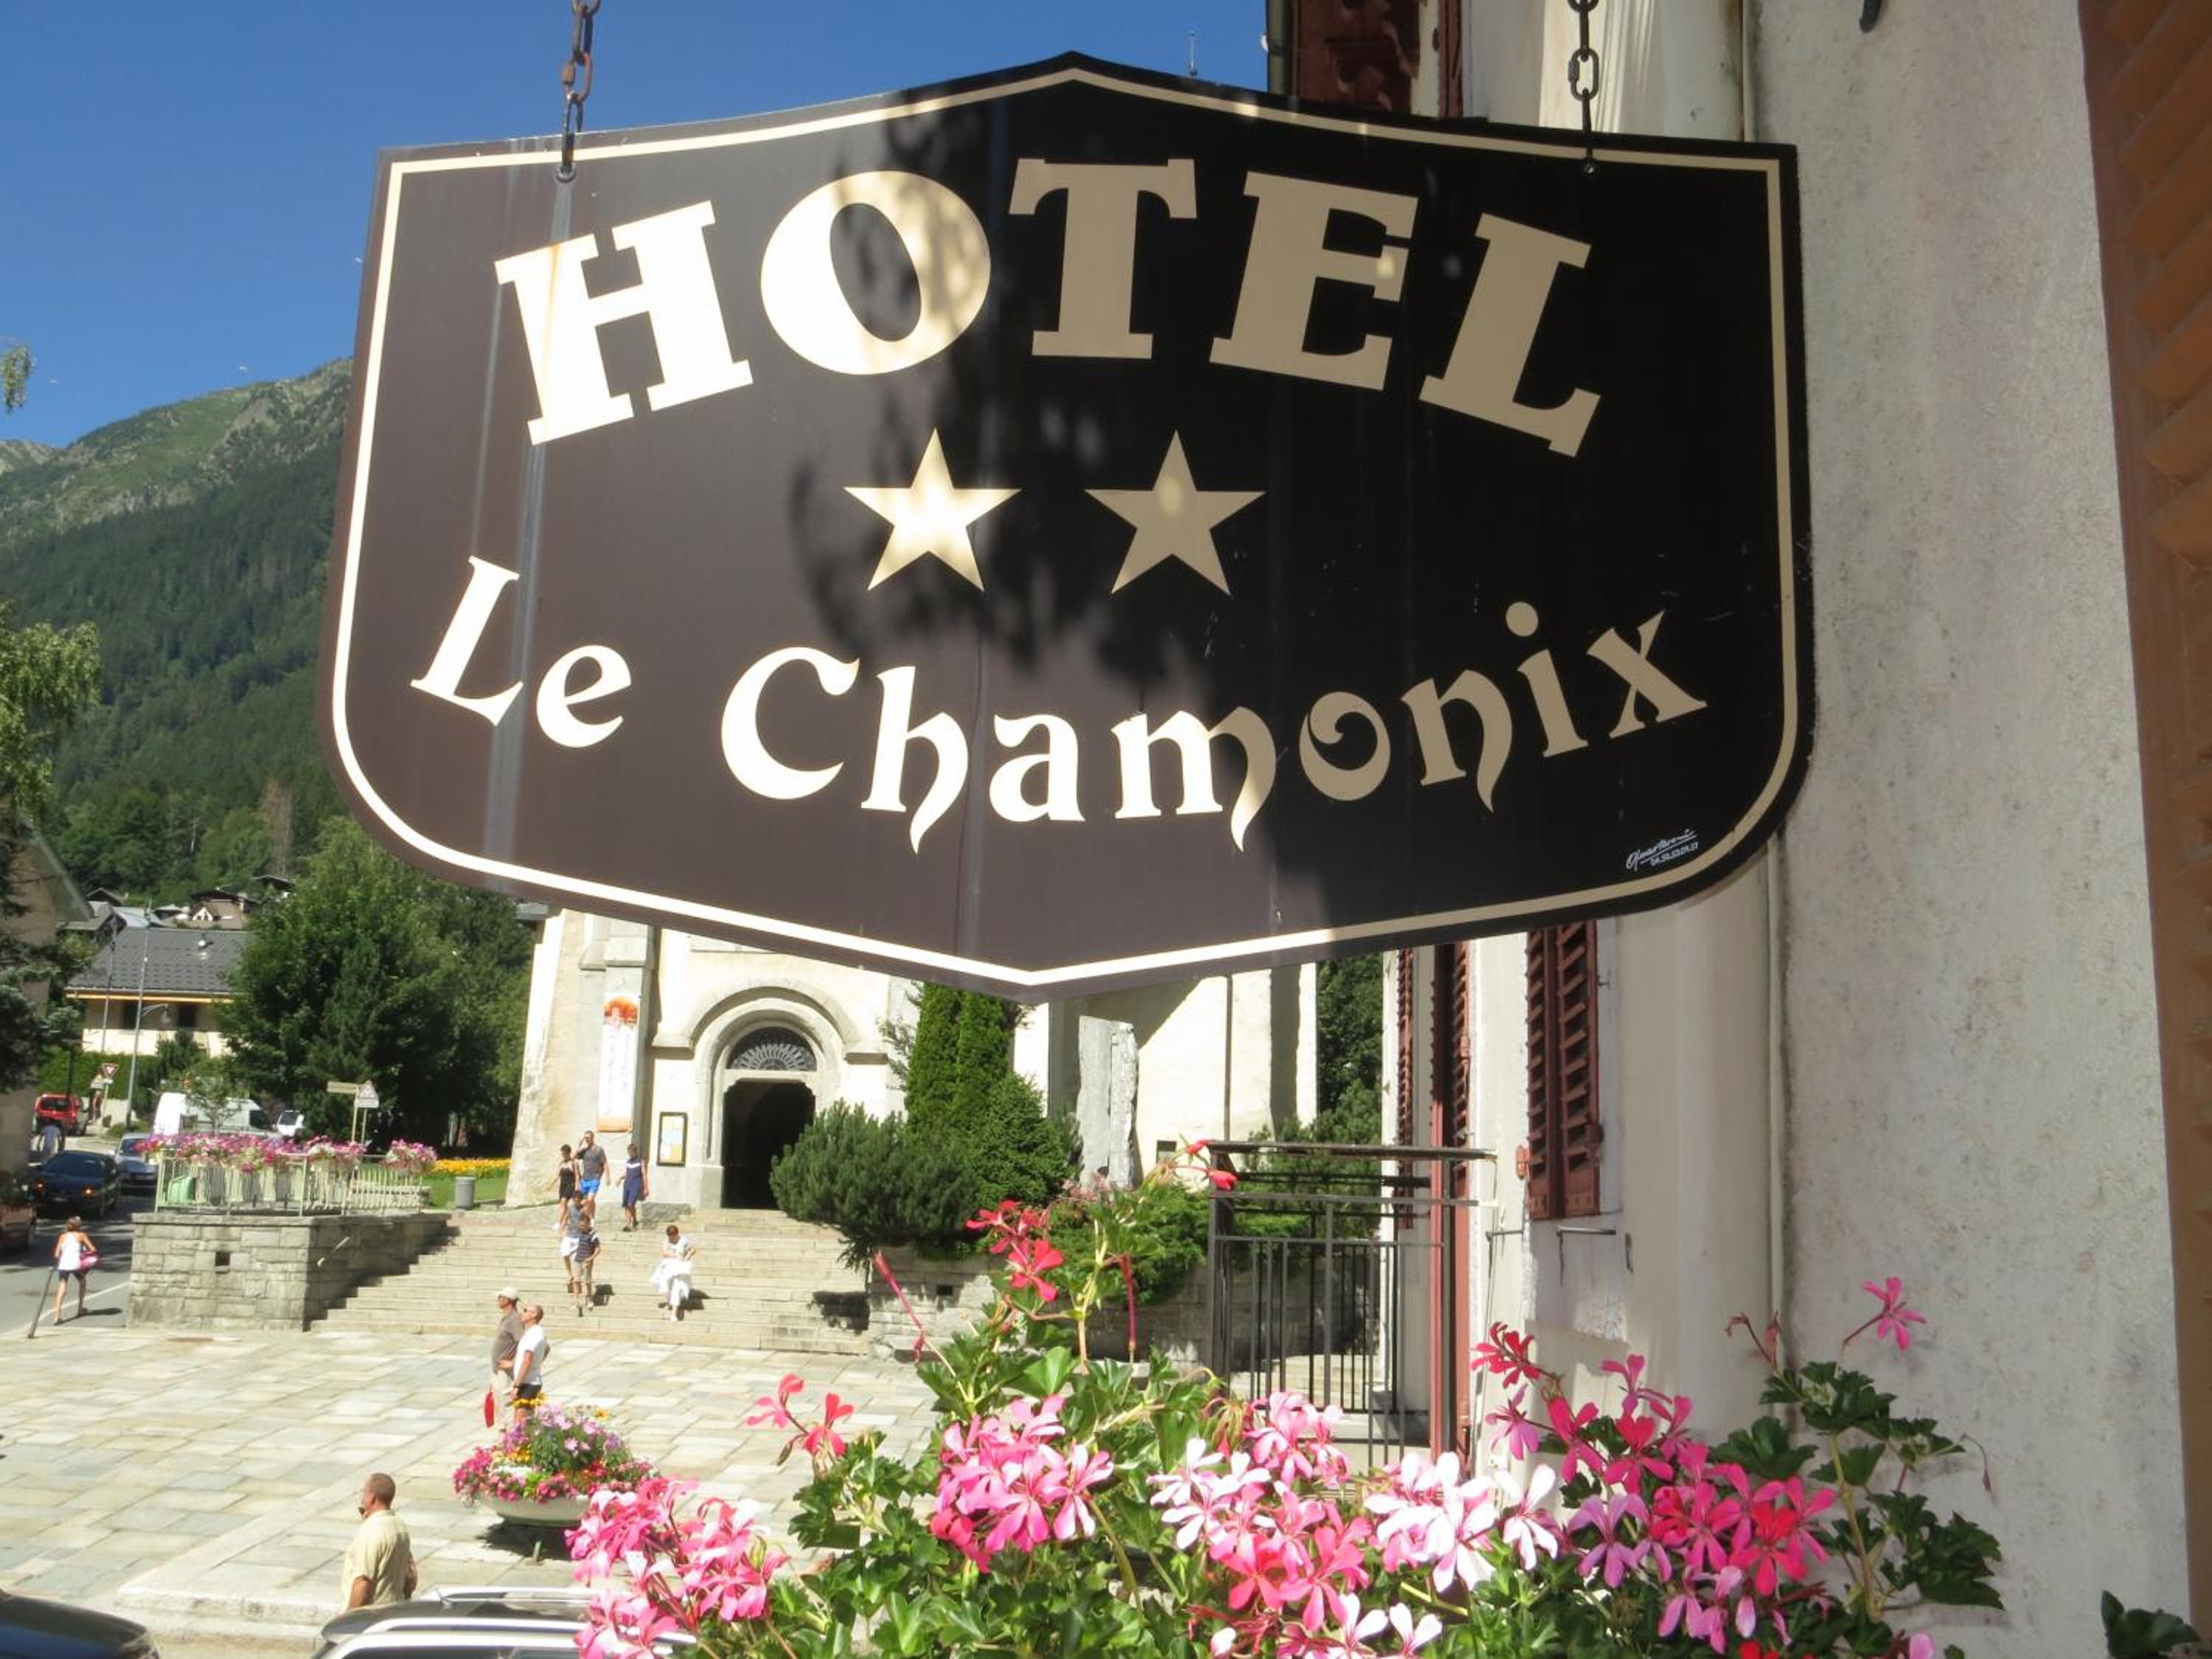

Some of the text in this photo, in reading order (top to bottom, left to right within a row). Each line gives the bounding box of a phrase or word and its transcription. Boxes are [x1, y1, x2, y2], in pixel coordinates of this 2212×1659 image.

[493, 158, 1601, 458] HOTEL
[410, 556, 1708, 855] Le Chamonix
